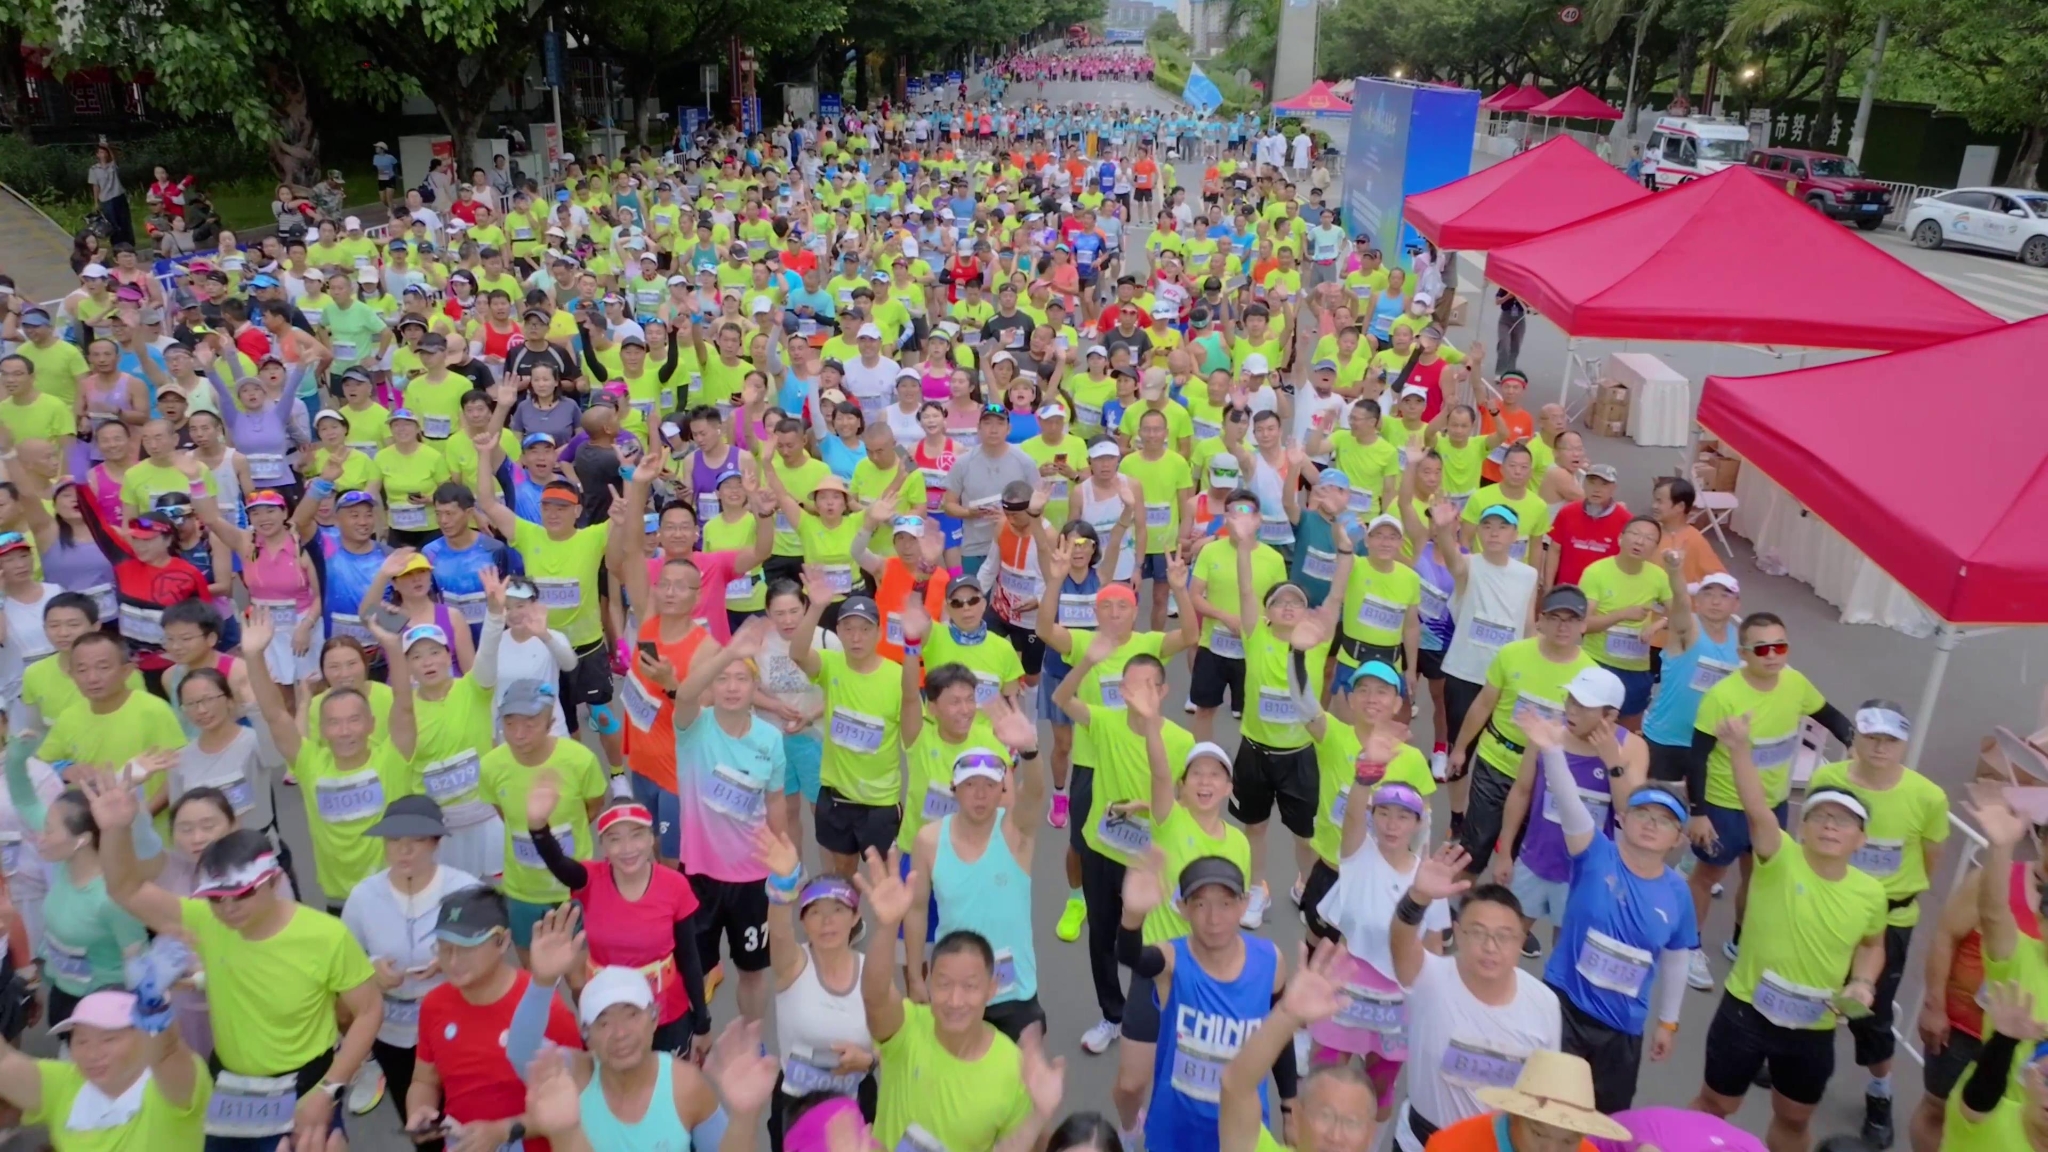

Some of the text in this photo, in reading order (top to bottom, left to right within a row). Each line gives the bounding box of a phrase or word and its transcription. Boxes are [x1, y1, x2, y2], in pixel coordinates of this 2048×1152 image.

[1564, 10, 1577, 20] 40
[835, 720, 876, 744] B1317
[430, 764, 476, 791] B2179
[218, 1099, 282, 1118] B1141
